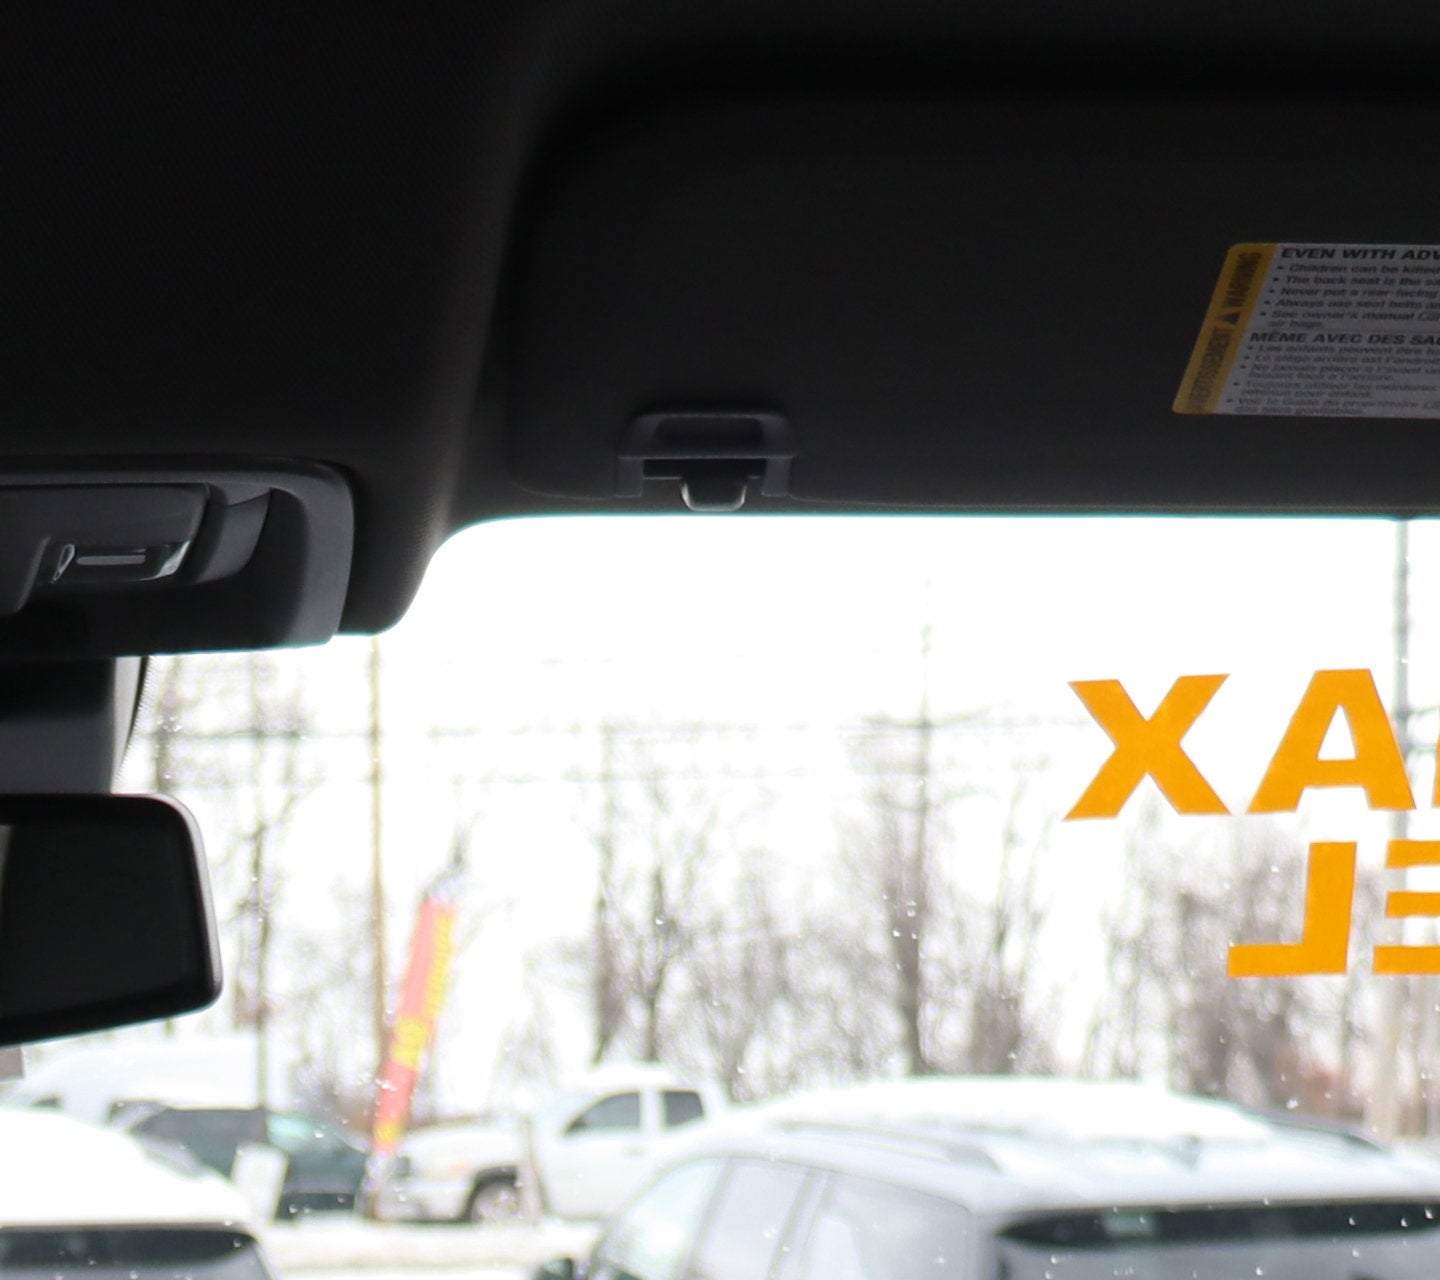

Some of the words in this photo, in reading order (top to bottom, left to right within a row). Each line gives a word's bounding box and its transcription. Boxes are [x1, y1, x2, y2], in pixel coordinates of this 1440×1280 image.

[1281, 247, 1336, 258] EVEN
[1342, 248, 1396, 259] WITH
[1312, 333, 1362, 344] AVEC
[1367, 334, 1405, 344] DES
